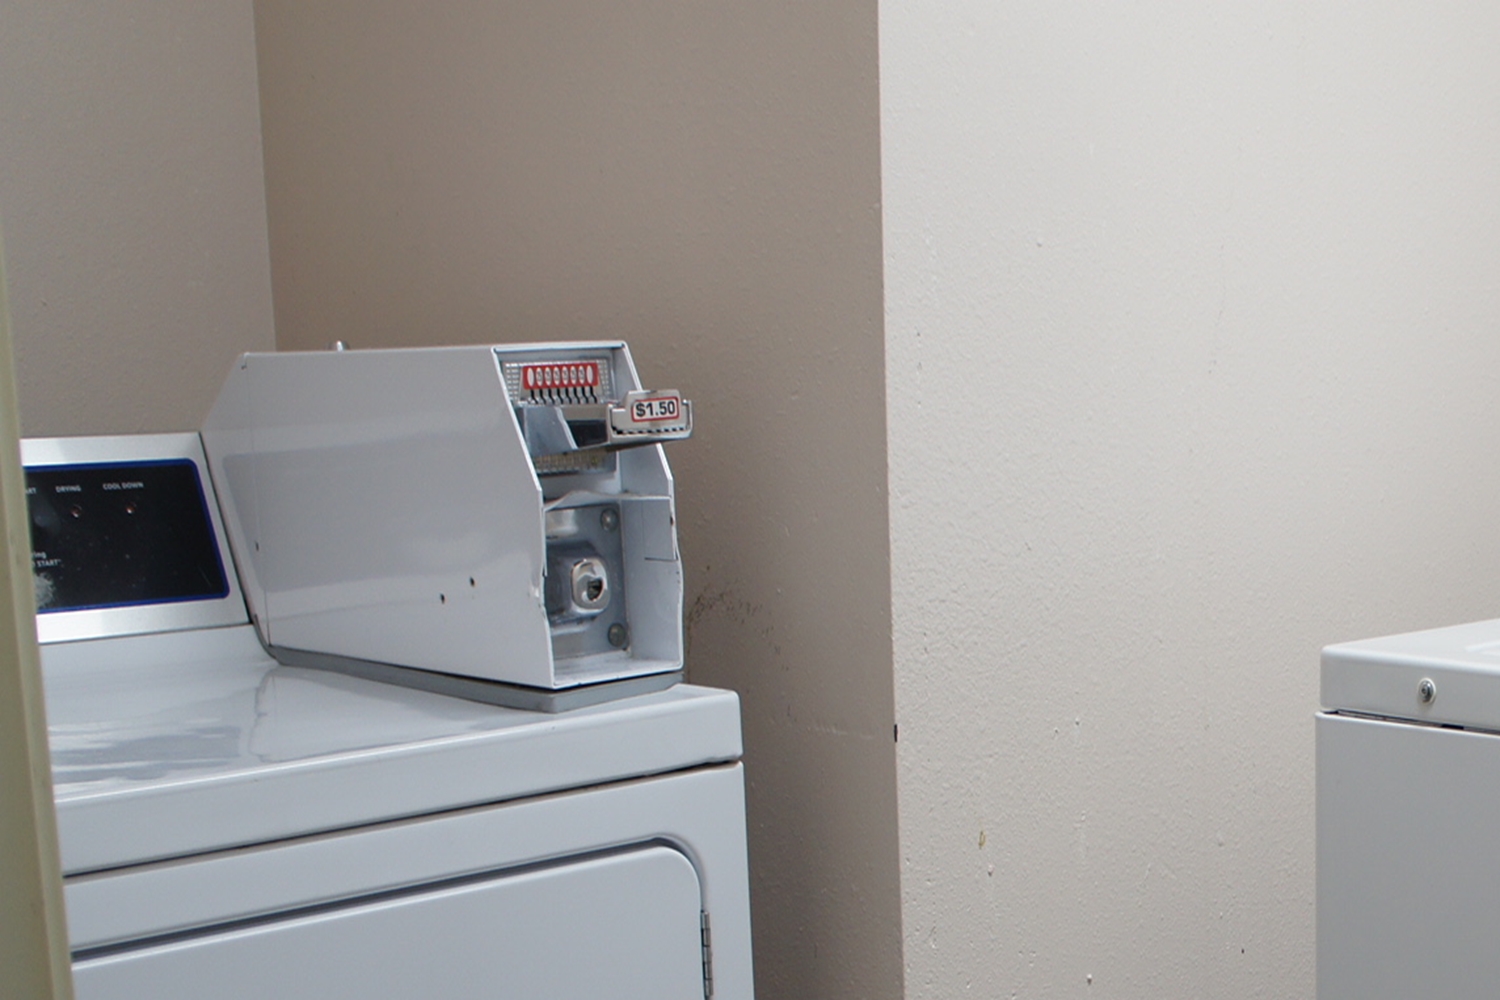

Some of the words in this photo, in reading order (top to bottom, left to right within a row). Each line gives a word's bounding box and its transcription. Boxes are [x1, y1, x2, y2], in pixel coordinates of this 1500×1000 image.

[635, 400, 676, 418] $1.50
[55, 484, 82, 493] DRYING
[102, 482, 121, 491] COOL
[122, 481, 144, 490] DOWN
